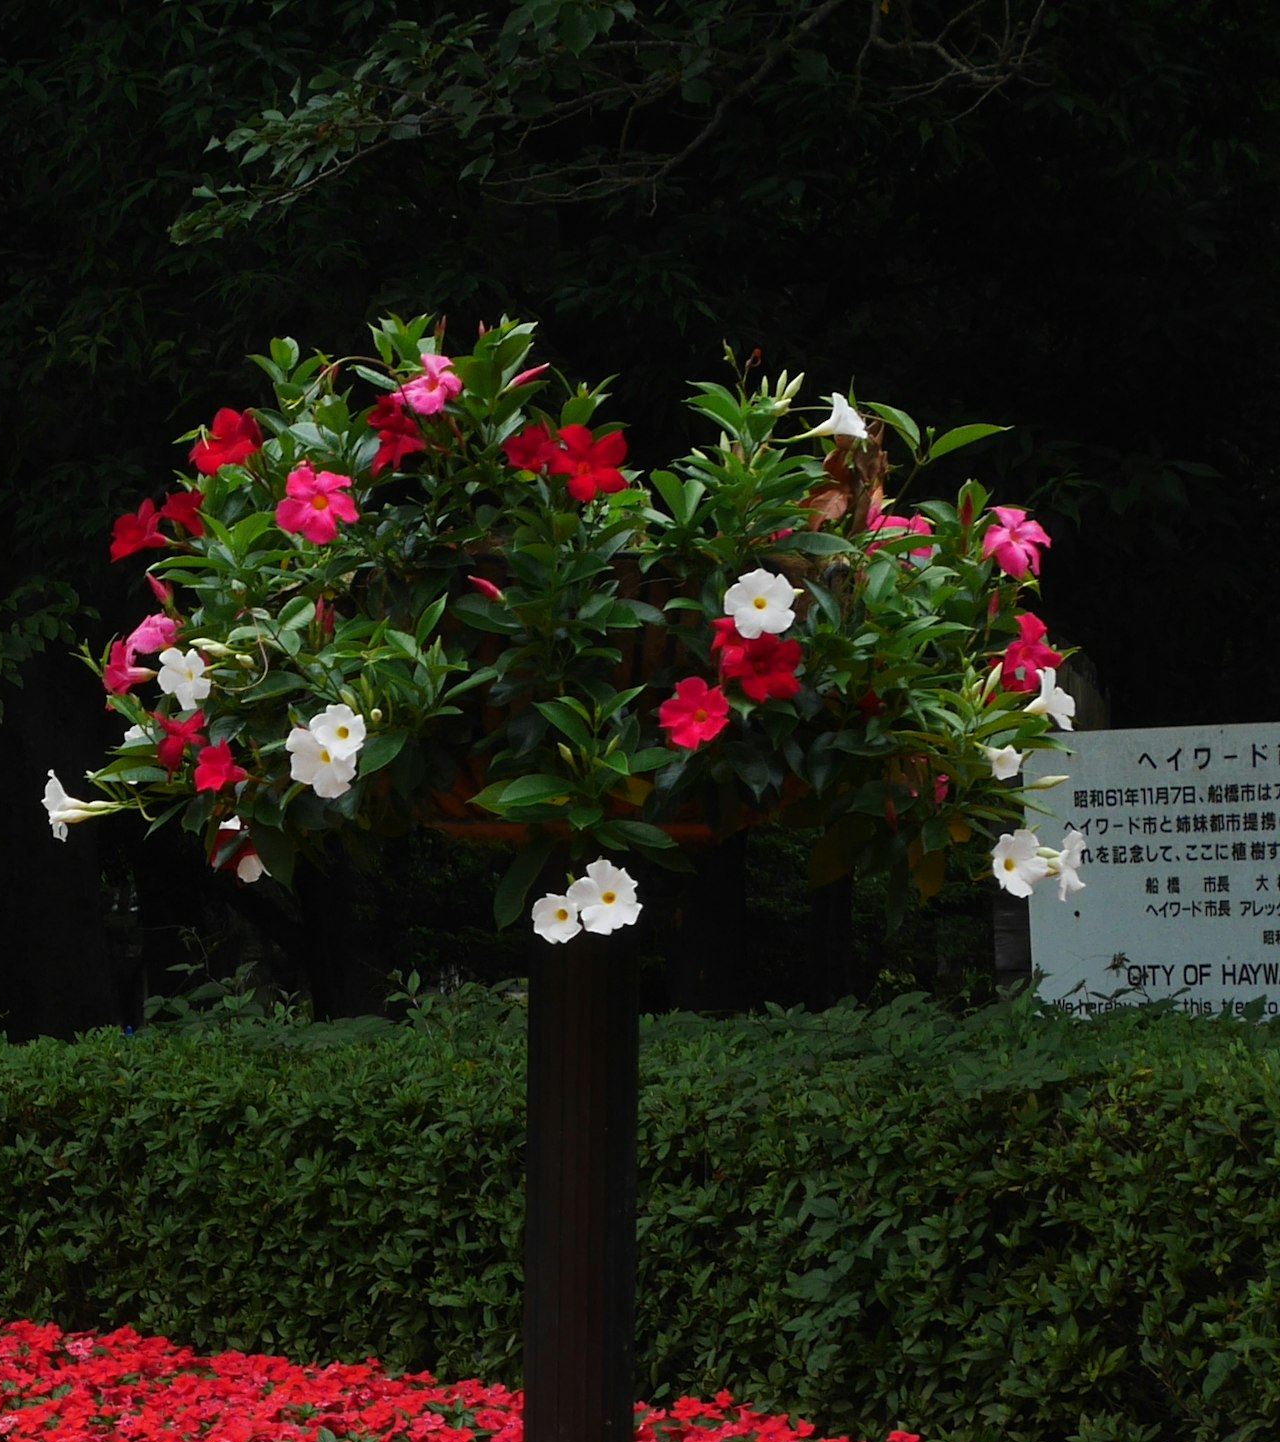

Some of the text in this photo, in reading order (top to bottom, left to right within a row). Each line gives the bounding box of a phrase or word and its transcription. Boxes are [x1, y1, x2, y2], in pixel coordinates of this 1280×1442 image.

[1137, 743, 1280, 772] ヘイワード
[1063, 811, 1280, 837] ヘイワード市と姉妹都市提携
[1127, 963, 1280, 986] CITY OF HAYW
[1183, 998, 1212, 1014] this
